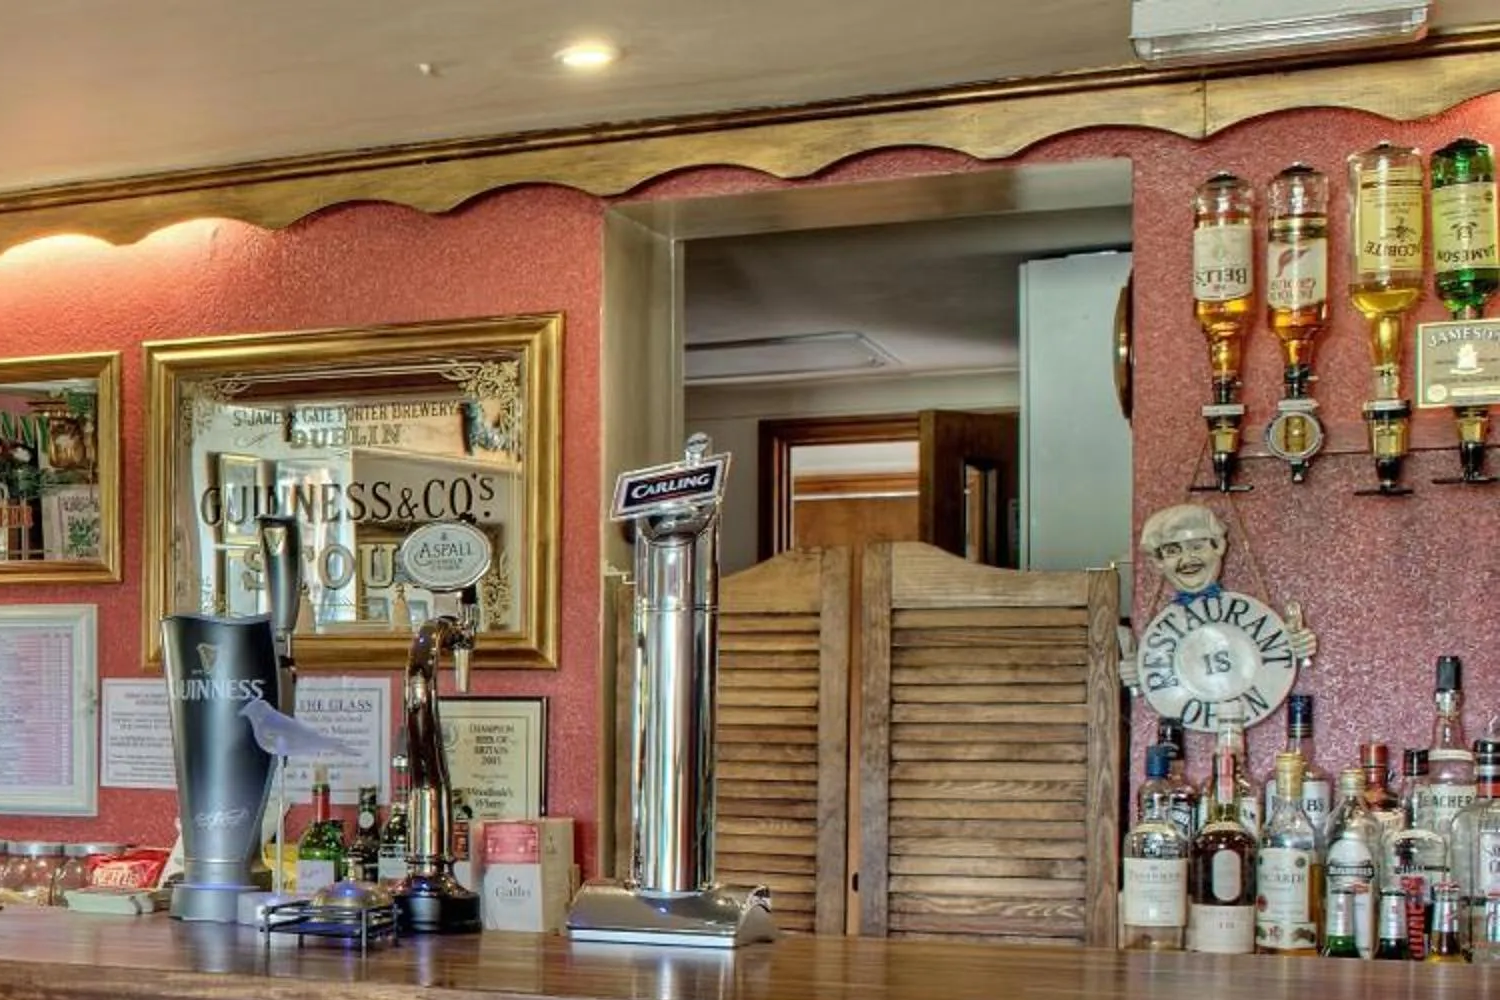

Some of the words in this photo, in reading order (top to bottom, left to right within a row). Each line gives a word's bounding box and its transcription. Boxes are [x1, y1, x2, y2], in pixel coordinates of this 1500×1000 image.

[1427, 326, 1500, 349] JAMESO
[392, 399, 456, 419] BREWERY
[631, 473, 711, 499] CARLING
[1143, 594, 1293, 693] RESTAURANT
[1203, 650, 1232, 676] IS
[1180, 685, 1271, 728] OPN
